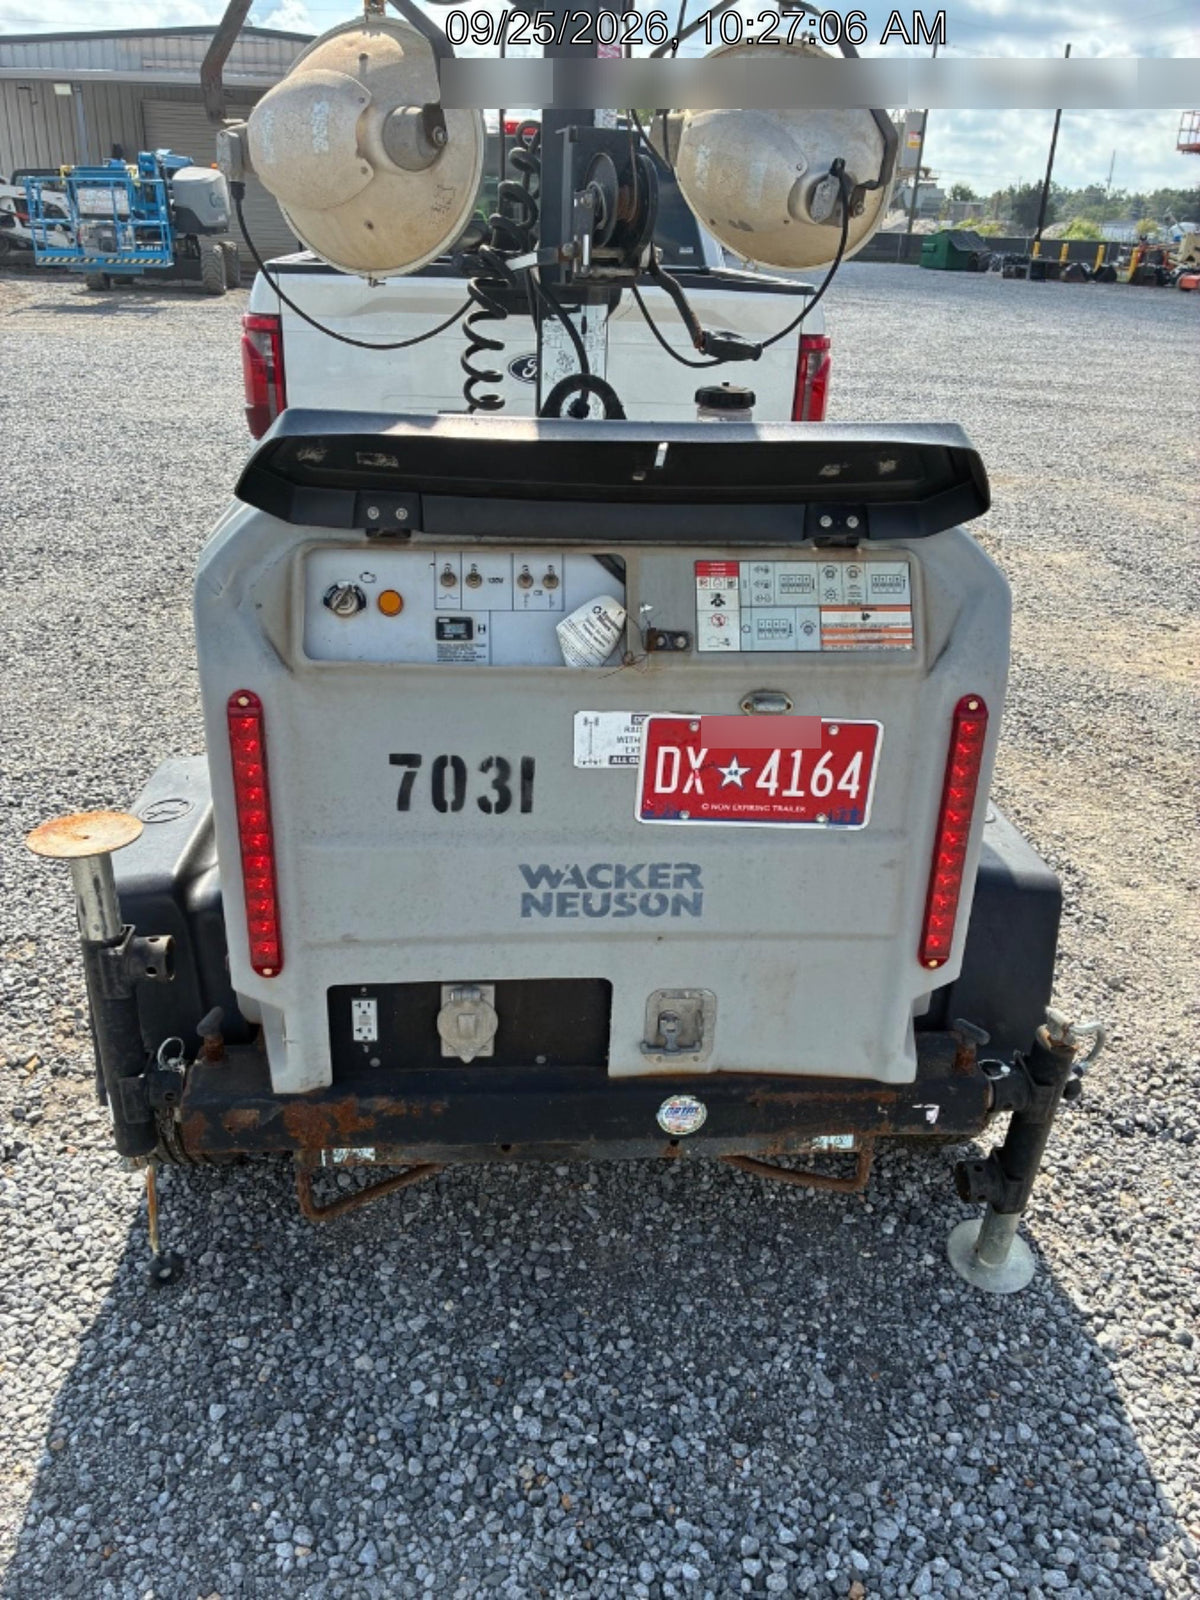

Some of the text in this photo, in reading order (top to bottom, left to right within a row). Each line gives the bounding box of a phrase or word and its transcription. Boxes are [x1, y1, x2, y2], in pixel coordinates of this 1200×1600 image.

[654, 746, 708, 795] DX
[755, 749, 863, 799] 4164
[518, 863, 704, 889] WACKER
[520, 892, 703, 917] NEUSON
